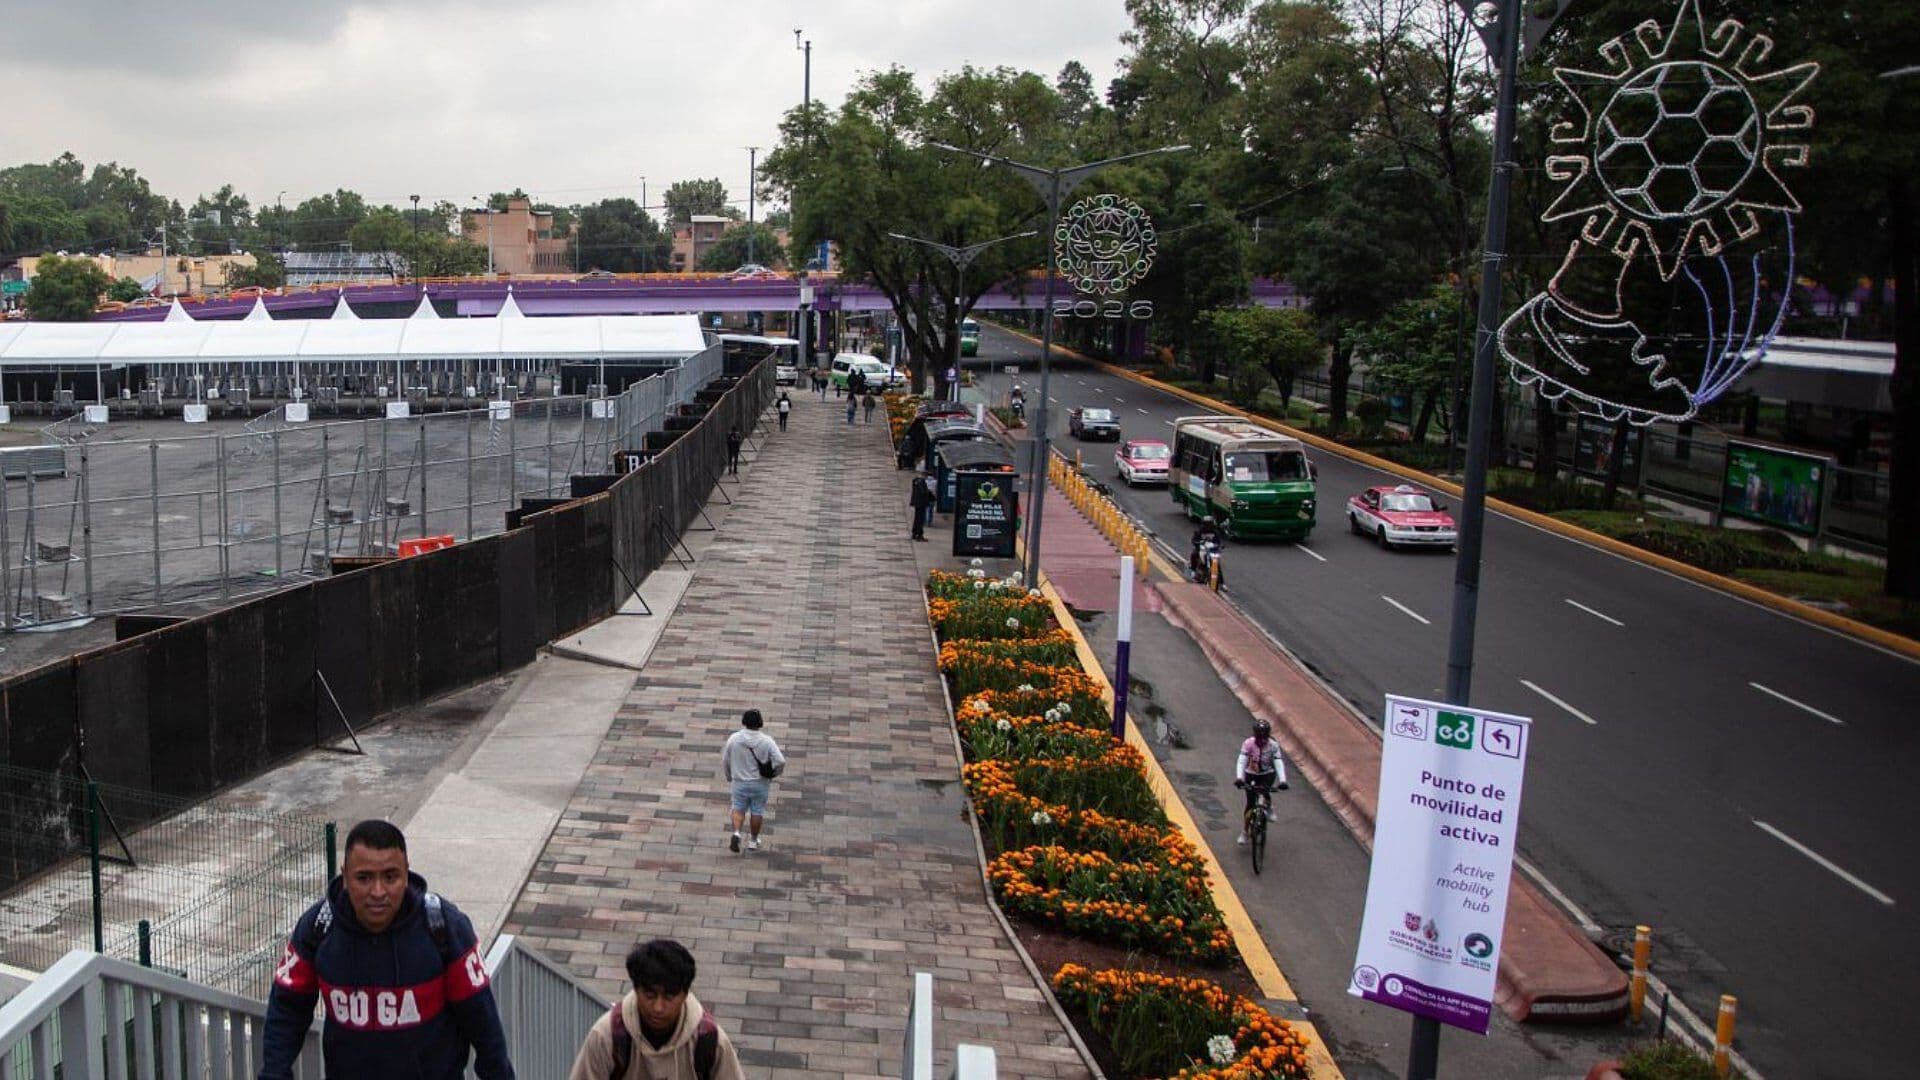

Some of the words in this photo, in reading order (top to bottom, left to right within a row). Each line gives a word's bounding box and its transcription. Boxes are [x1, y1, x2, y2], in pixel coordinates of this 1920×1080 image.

[1052, 300, 1153, 319] 2026
[1421, 770, 1476, 795] Punto
[1482, 784, 1506, 801] de
[1410, 793, 1503, 824] movilidad
[1440, 825, 1500, 847] activa
[1453, 863, 1495, 881] Active
[1437, 877, 1494, 899] mobility
[1463, 896, 1490, 913] hub
